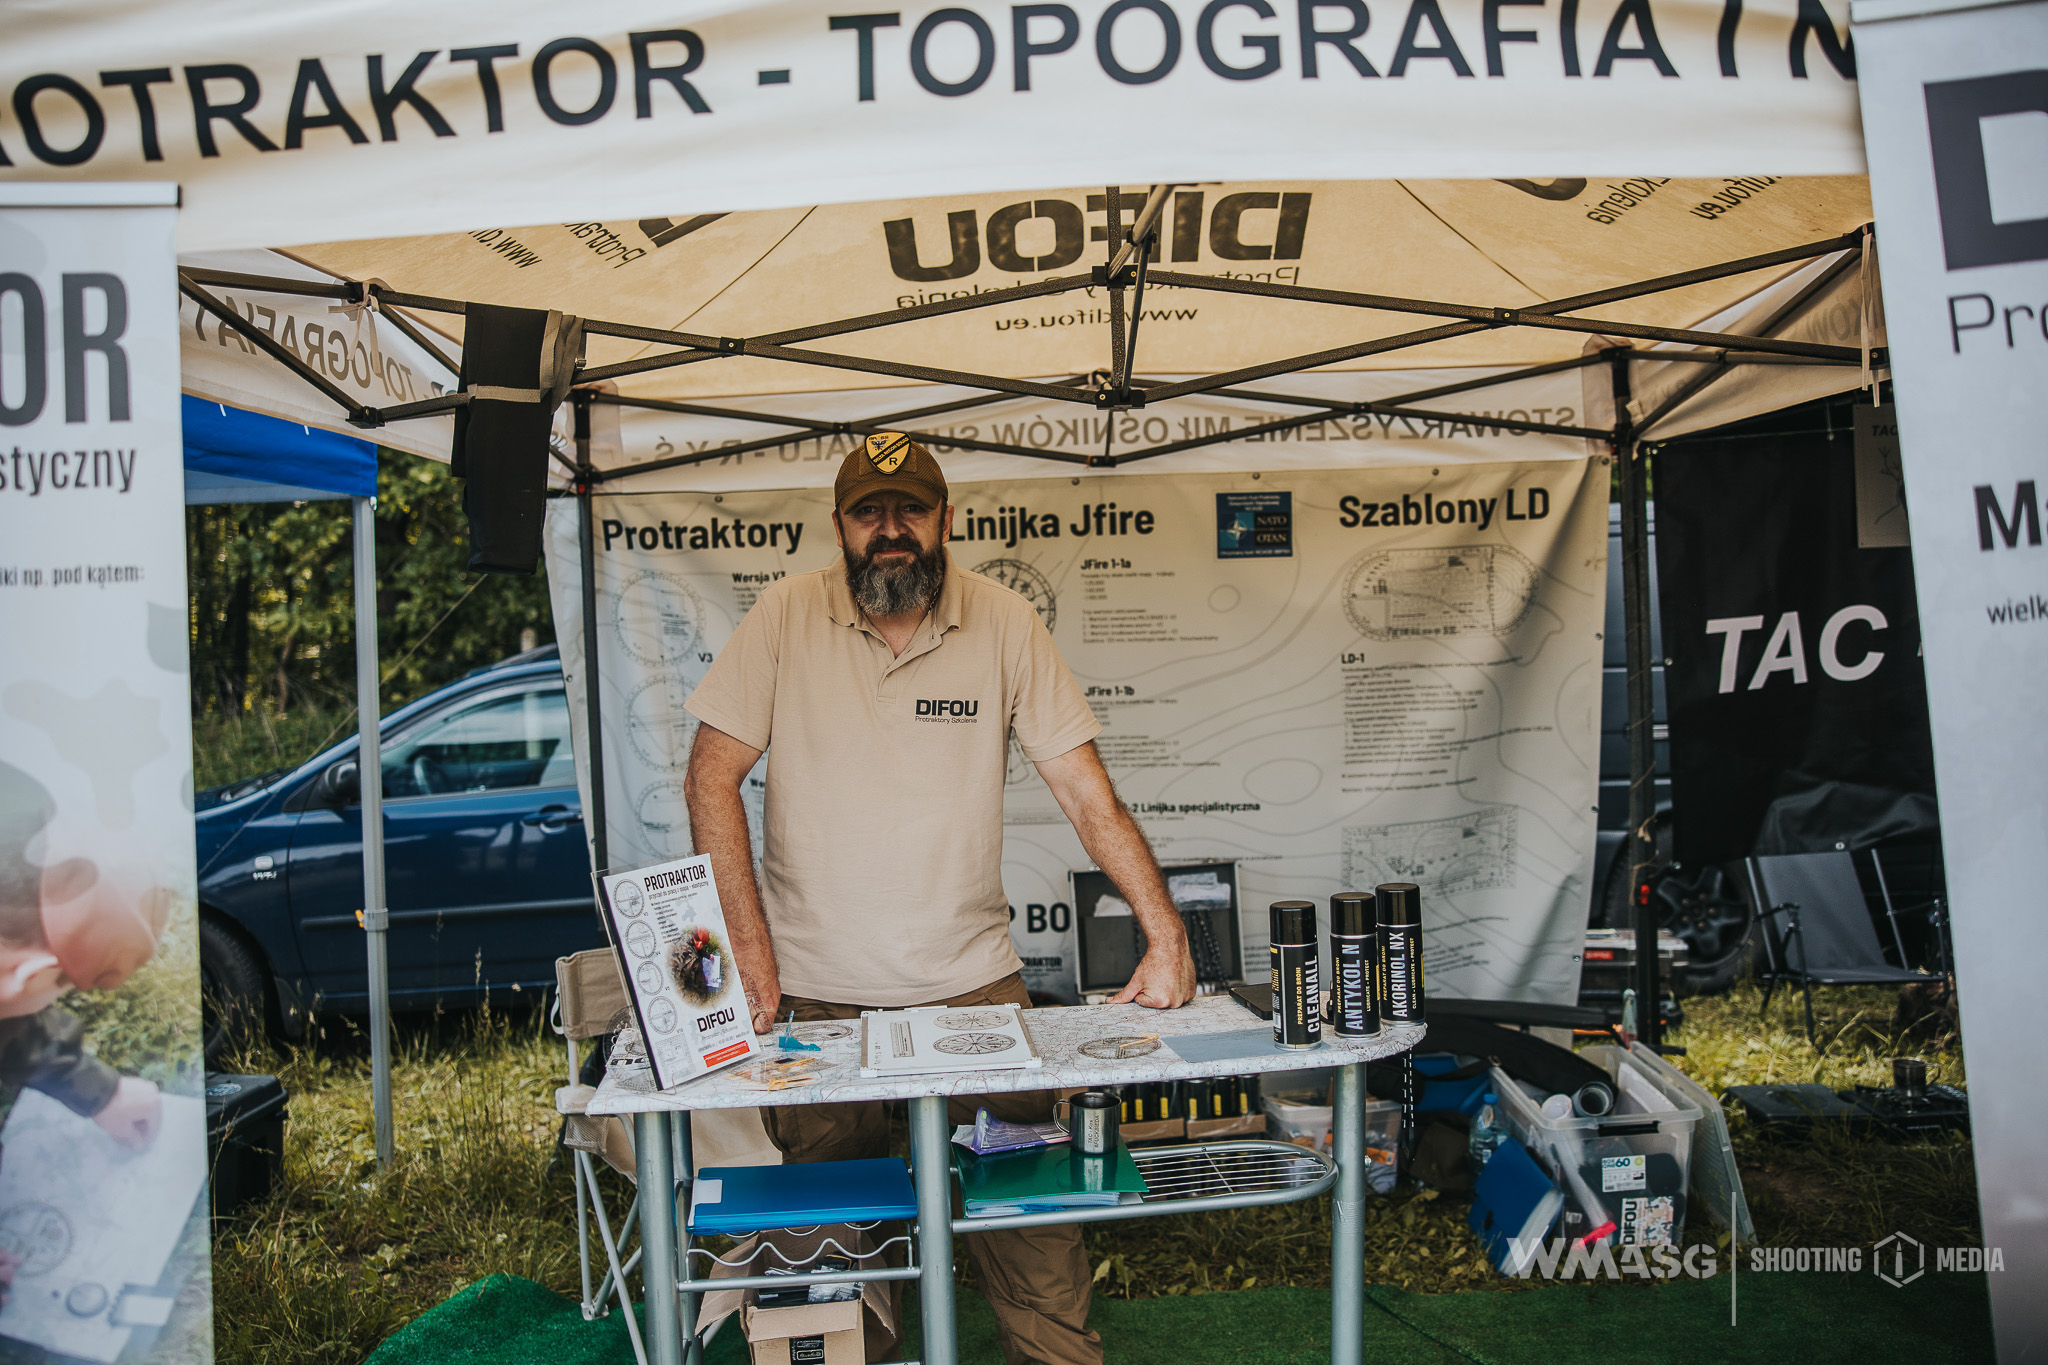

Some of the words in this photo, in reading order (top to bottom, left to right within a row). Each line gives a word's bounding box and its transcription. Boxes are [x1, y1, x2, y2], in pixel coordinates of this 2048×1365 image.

[0, 29, 713, 167] OTRAKTOR
[829, 0, 1680, 103] TOPOGRAFIA
[1948, 292, 2048, 355] Pr
[889, 457, 898, 466] R
[1070, 502, 1155, 537] Jfire
[1339, 489, 1498, 531] Szablony
[1506, 487, 1550, 521] LD
[1973, 480, 2048, 552] M
[602, 517, 803, 555] Protraktory
[732, 571, 770, 585] Wersja
[1341, 653, 1365, 664] LD-1
[1706, 604, 1889, 694] TAC
[916, 699, 978, 717] DIFOU
[643, 864, 707, 892] PROTRAKTOR
[1341, 944, 1360, 955] N
[1389, 931, 1404, 950] NX
[1304, 955, 1320, 1034] CLEANALL
[1343, 959, 1364, 1031] ANTYKOL
[1391, 953, 1408, 1017] AKORINOL
[696, 1006, 735, 1032] DIFOU
[1296, 995, 1304, 1025] PREPARAT
[1615, 1157, 1630, 1167] 60
[1623, 1201, 1637, 1245] DIFOU
